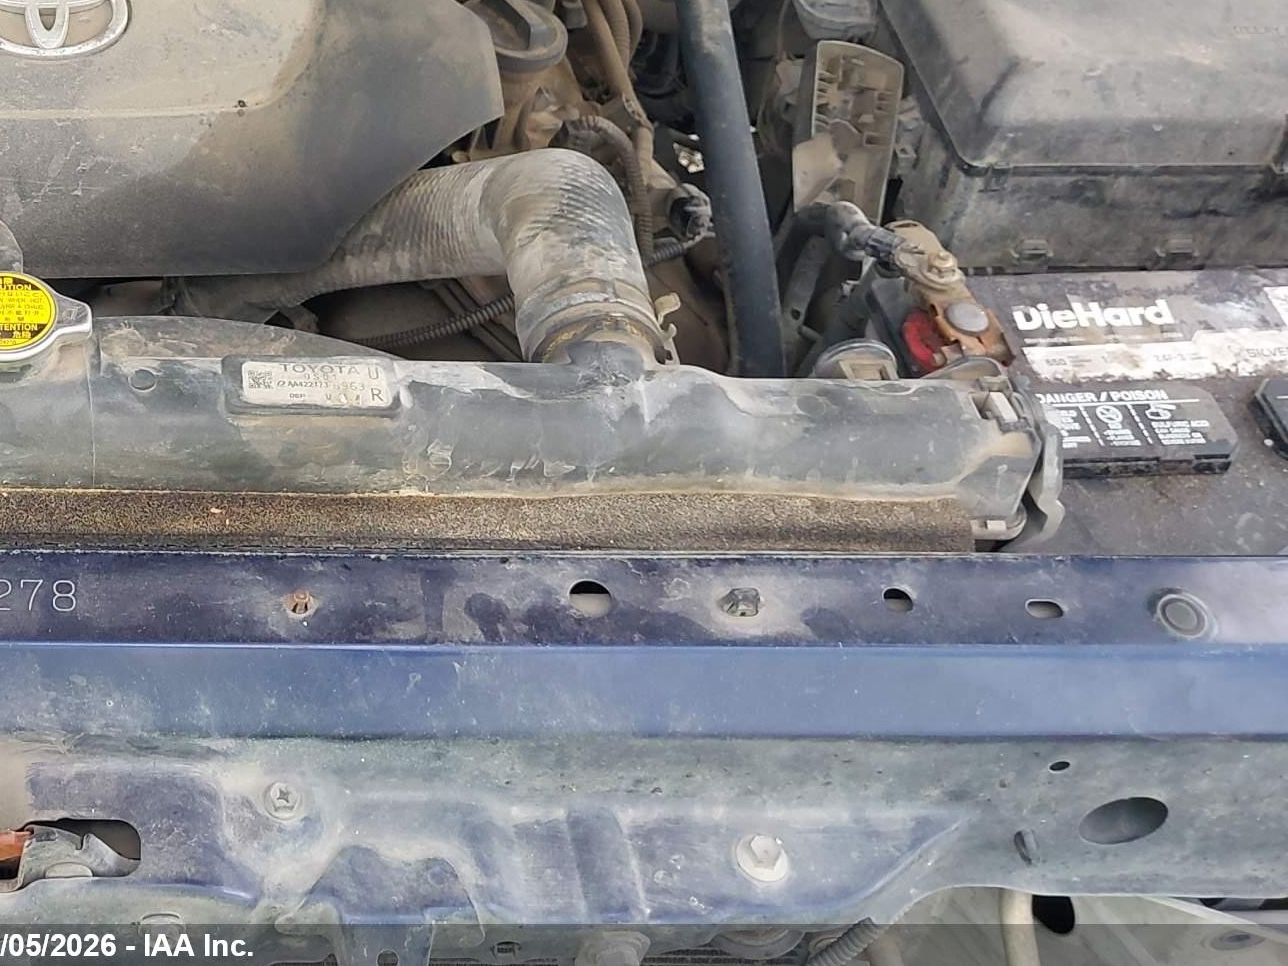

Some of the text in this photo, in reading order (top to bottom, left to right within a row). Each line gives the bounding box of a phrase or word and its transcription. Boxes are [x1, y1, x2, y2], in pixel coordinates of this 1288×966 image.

[1013, 299, 1176, 330] DieHard
[279, 363, 361, 375] TOYOTA
[371, 388, 385, 403] R
[1111, 390, 1169, 401] POISON
